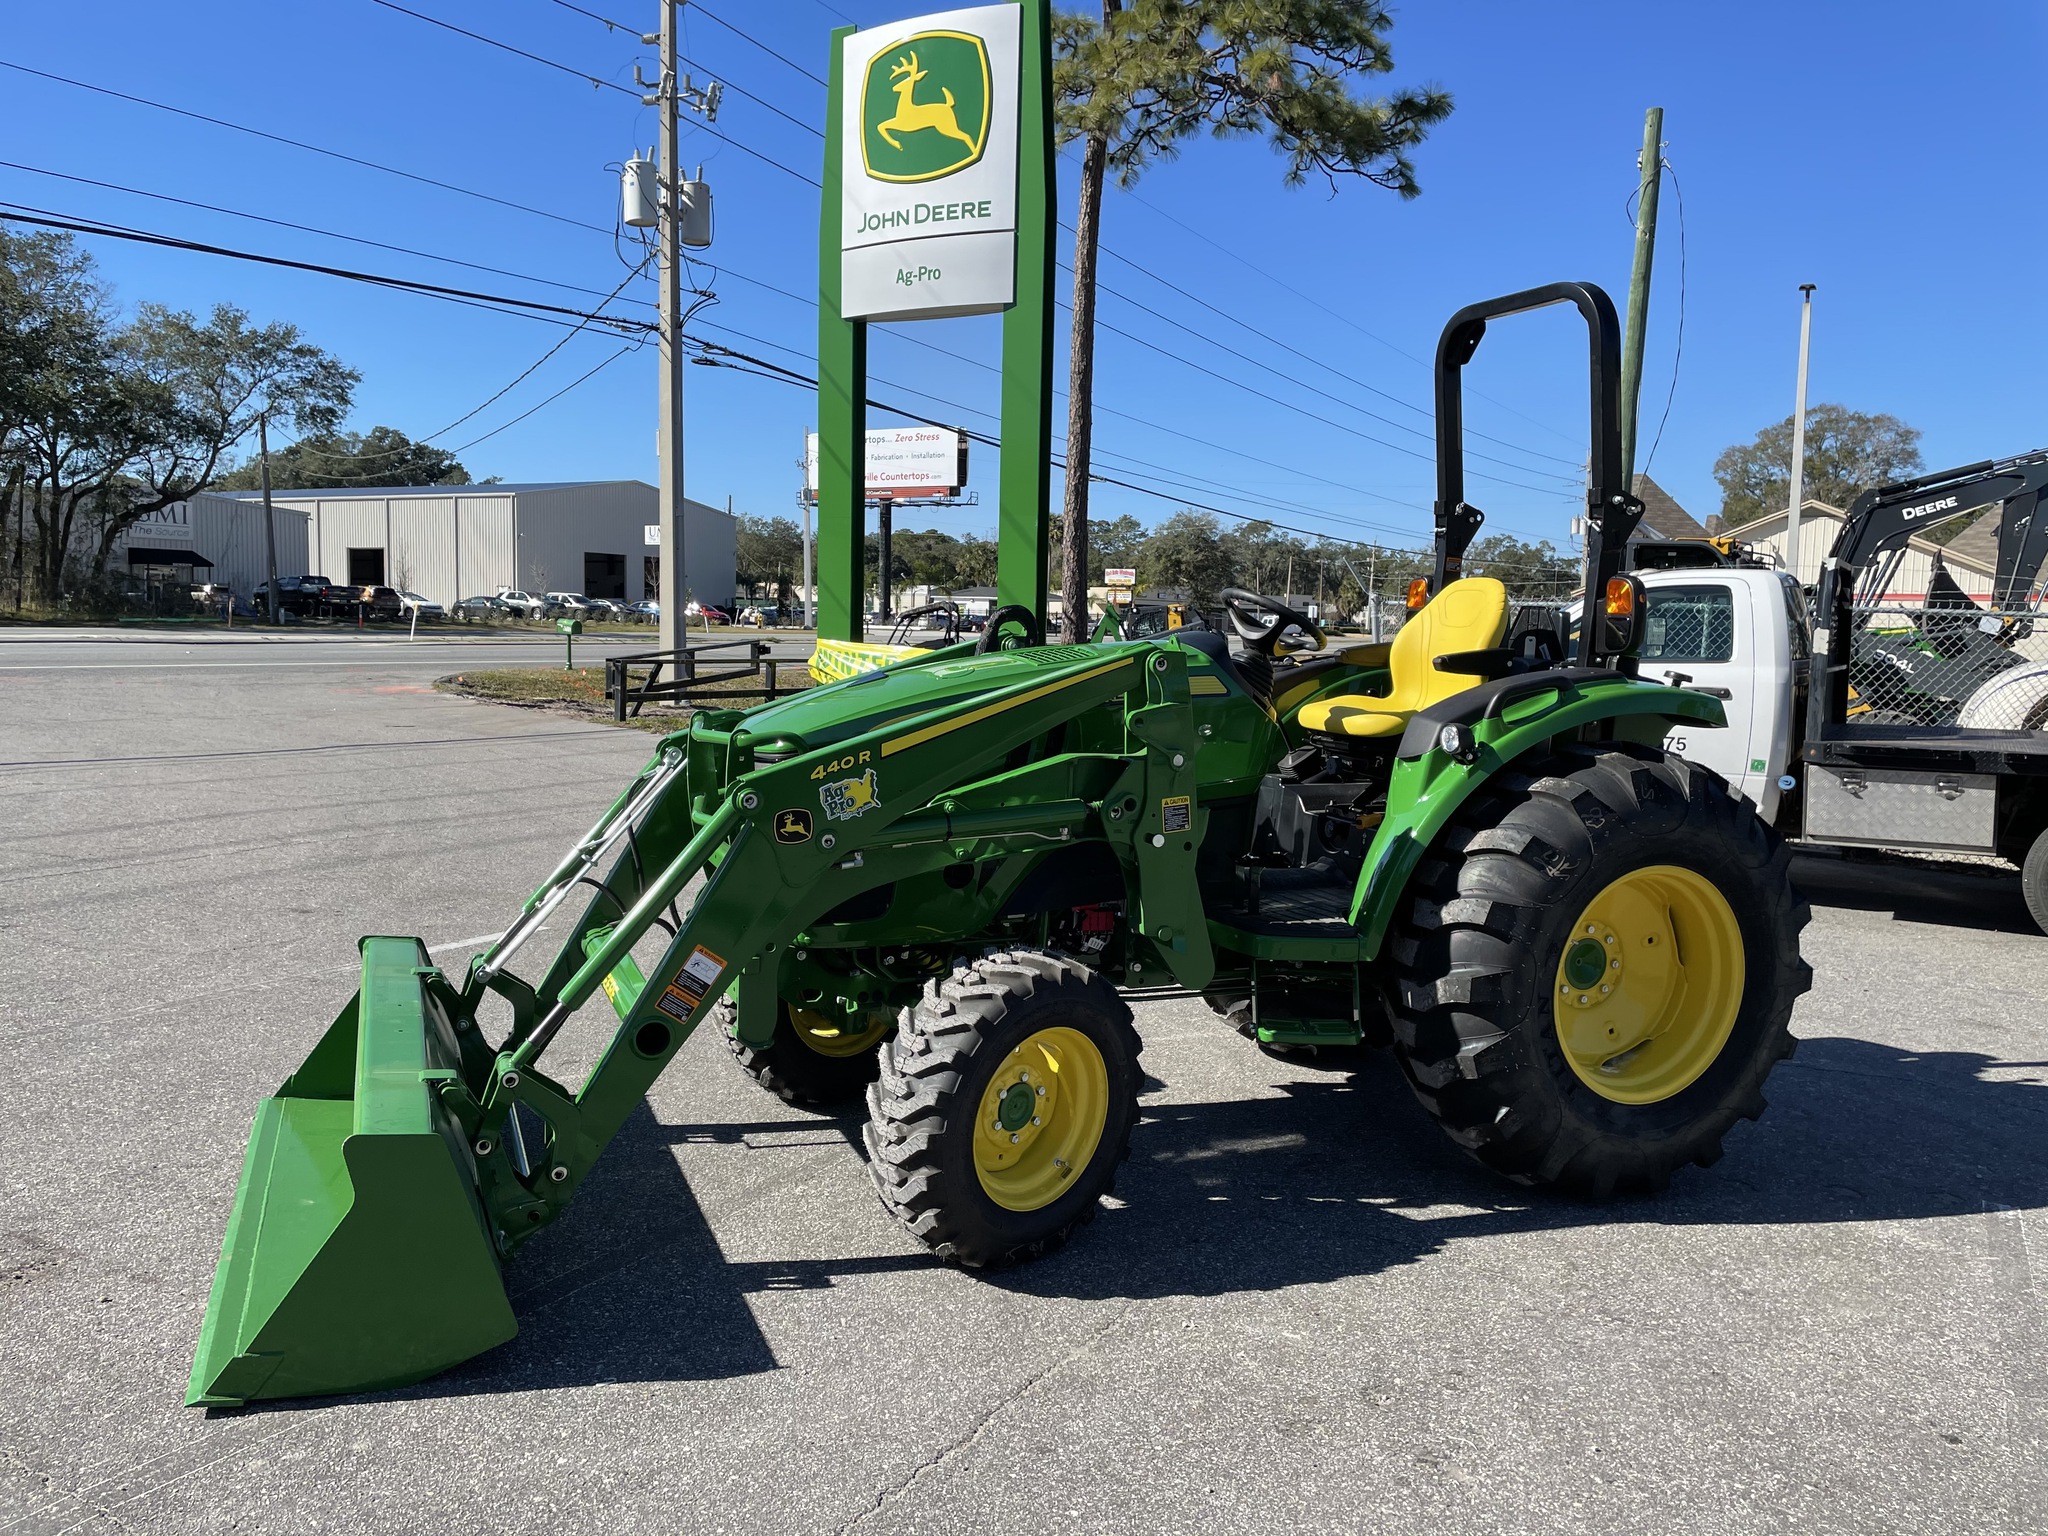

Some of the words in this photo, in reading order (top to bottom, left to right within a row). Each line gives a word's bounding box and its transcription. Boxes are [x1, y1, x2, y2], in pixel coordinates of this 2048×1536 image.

[857, 208, 910, 233] JOHN
[914, 200, 992, 224] DEERE
[896, 266, 941, 286] Ag-Pro
[895, 433, 913, 442] Zero
[915, 432, 940, 441] Stress
[871, 452, 903, 460] Fabrication
[911, 451, 945, 459] Installation
[1902, 496, 1958, 520] DEERE
[134, 525, 152, 535] The
[155, 526, 190, 537] Source
[1664, 736, 1687, 752] 75
[823, 784, 850, 804] Ag-
[1170, 797, 1188, 805] CAUTION
[827, 796, 856, 817] Pro
